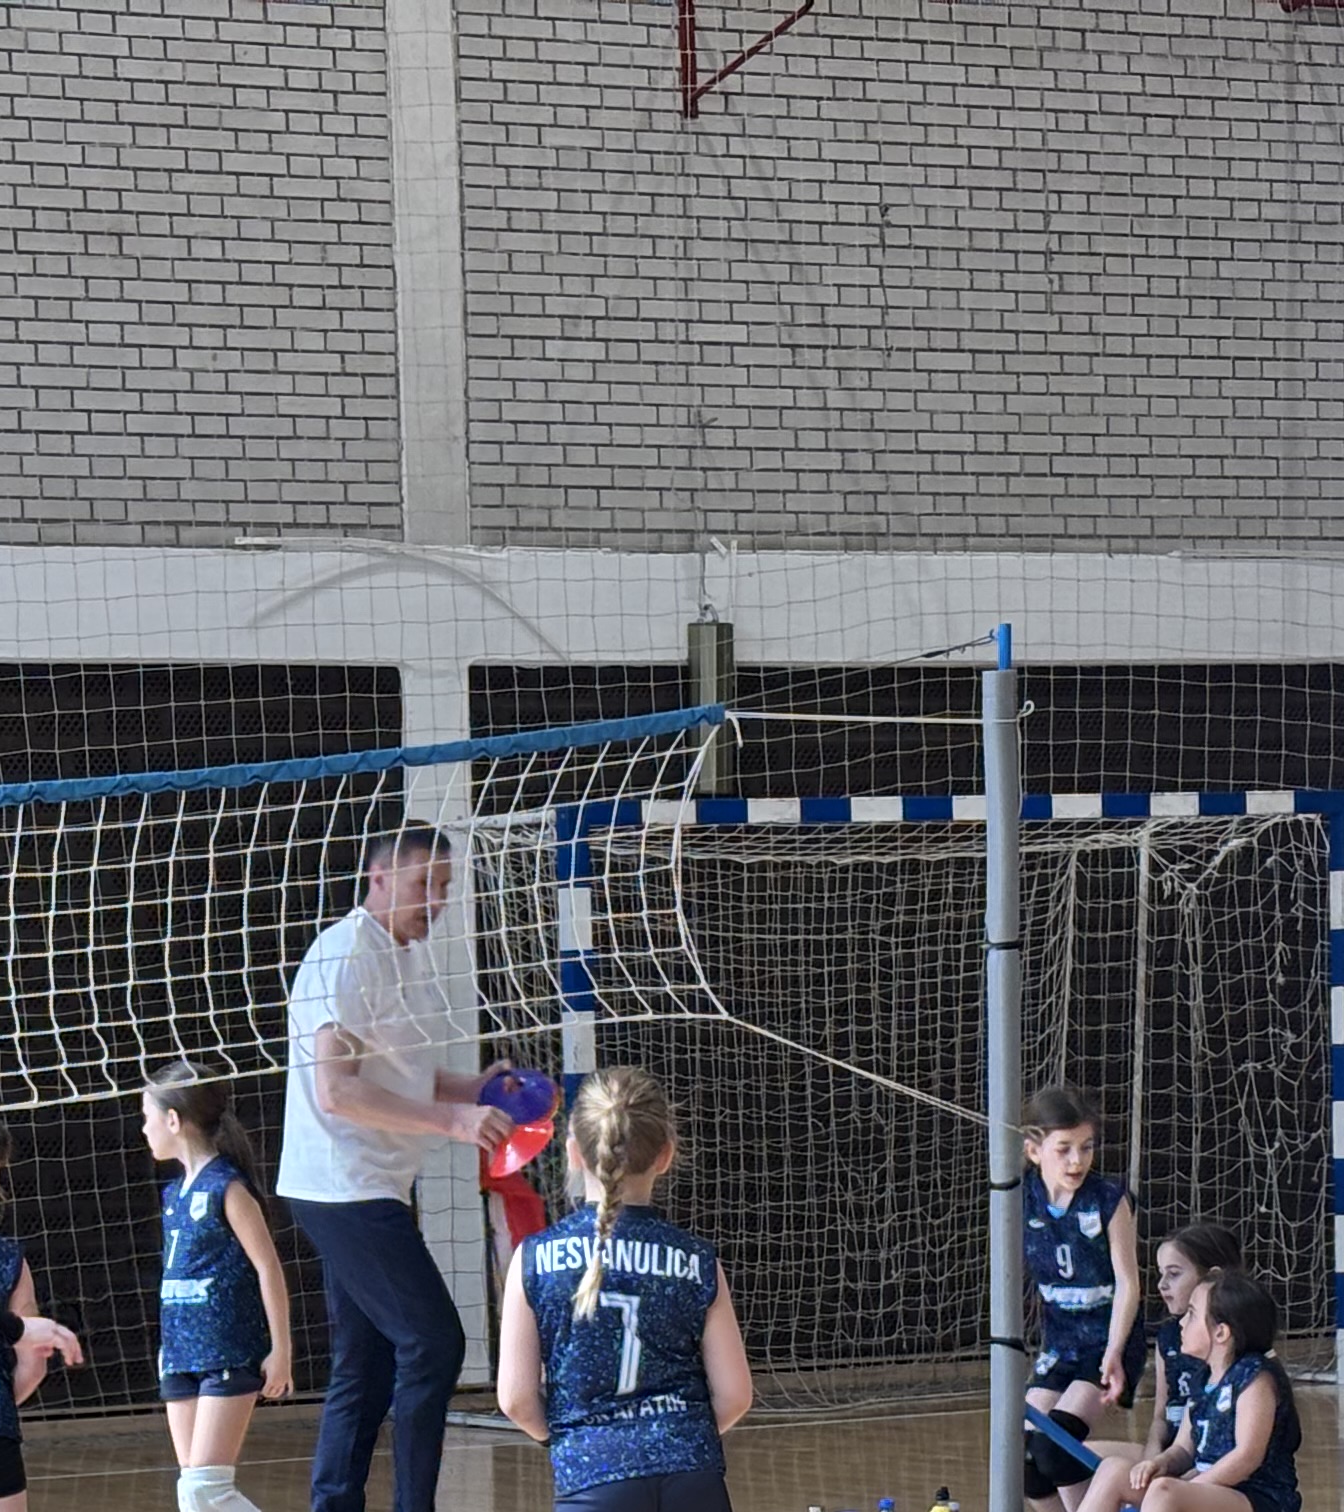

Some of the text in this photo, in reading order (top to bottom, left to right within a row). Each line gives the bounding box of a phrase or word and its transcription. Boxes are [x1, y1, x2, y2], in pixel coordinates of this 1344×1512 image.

[1056, 1243, 1075, 1279] 9
[599, 1291, 642, 1396] 7
[1196, 1419, 1210, 1454] 7
